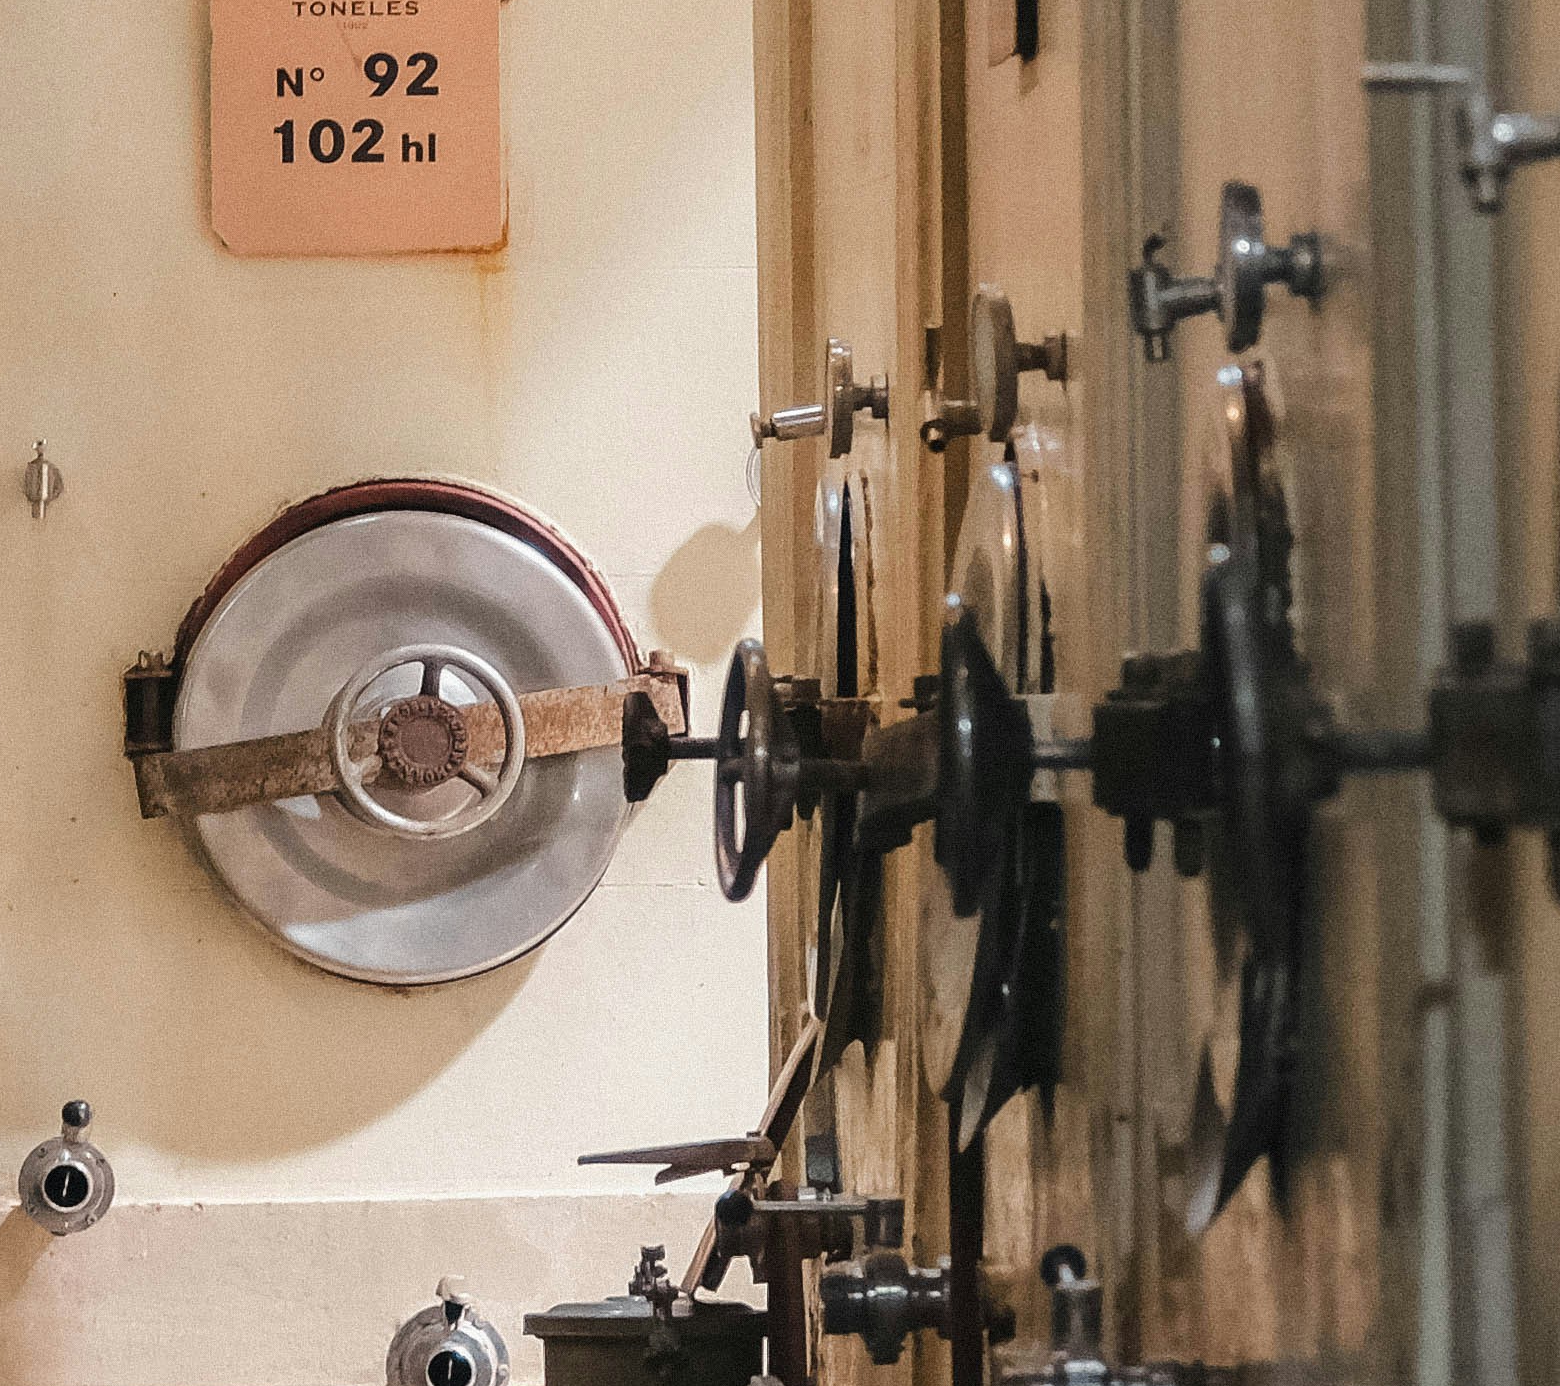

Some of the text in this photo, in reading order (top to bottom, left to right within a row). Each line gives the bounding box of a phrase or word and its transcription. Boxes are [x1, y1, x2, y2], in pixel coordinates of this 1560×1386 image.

[291, 0, 419, 17] TONELES
[363, 51, 440, 98] 92
[273, 118, 437, 164] 102 hl
